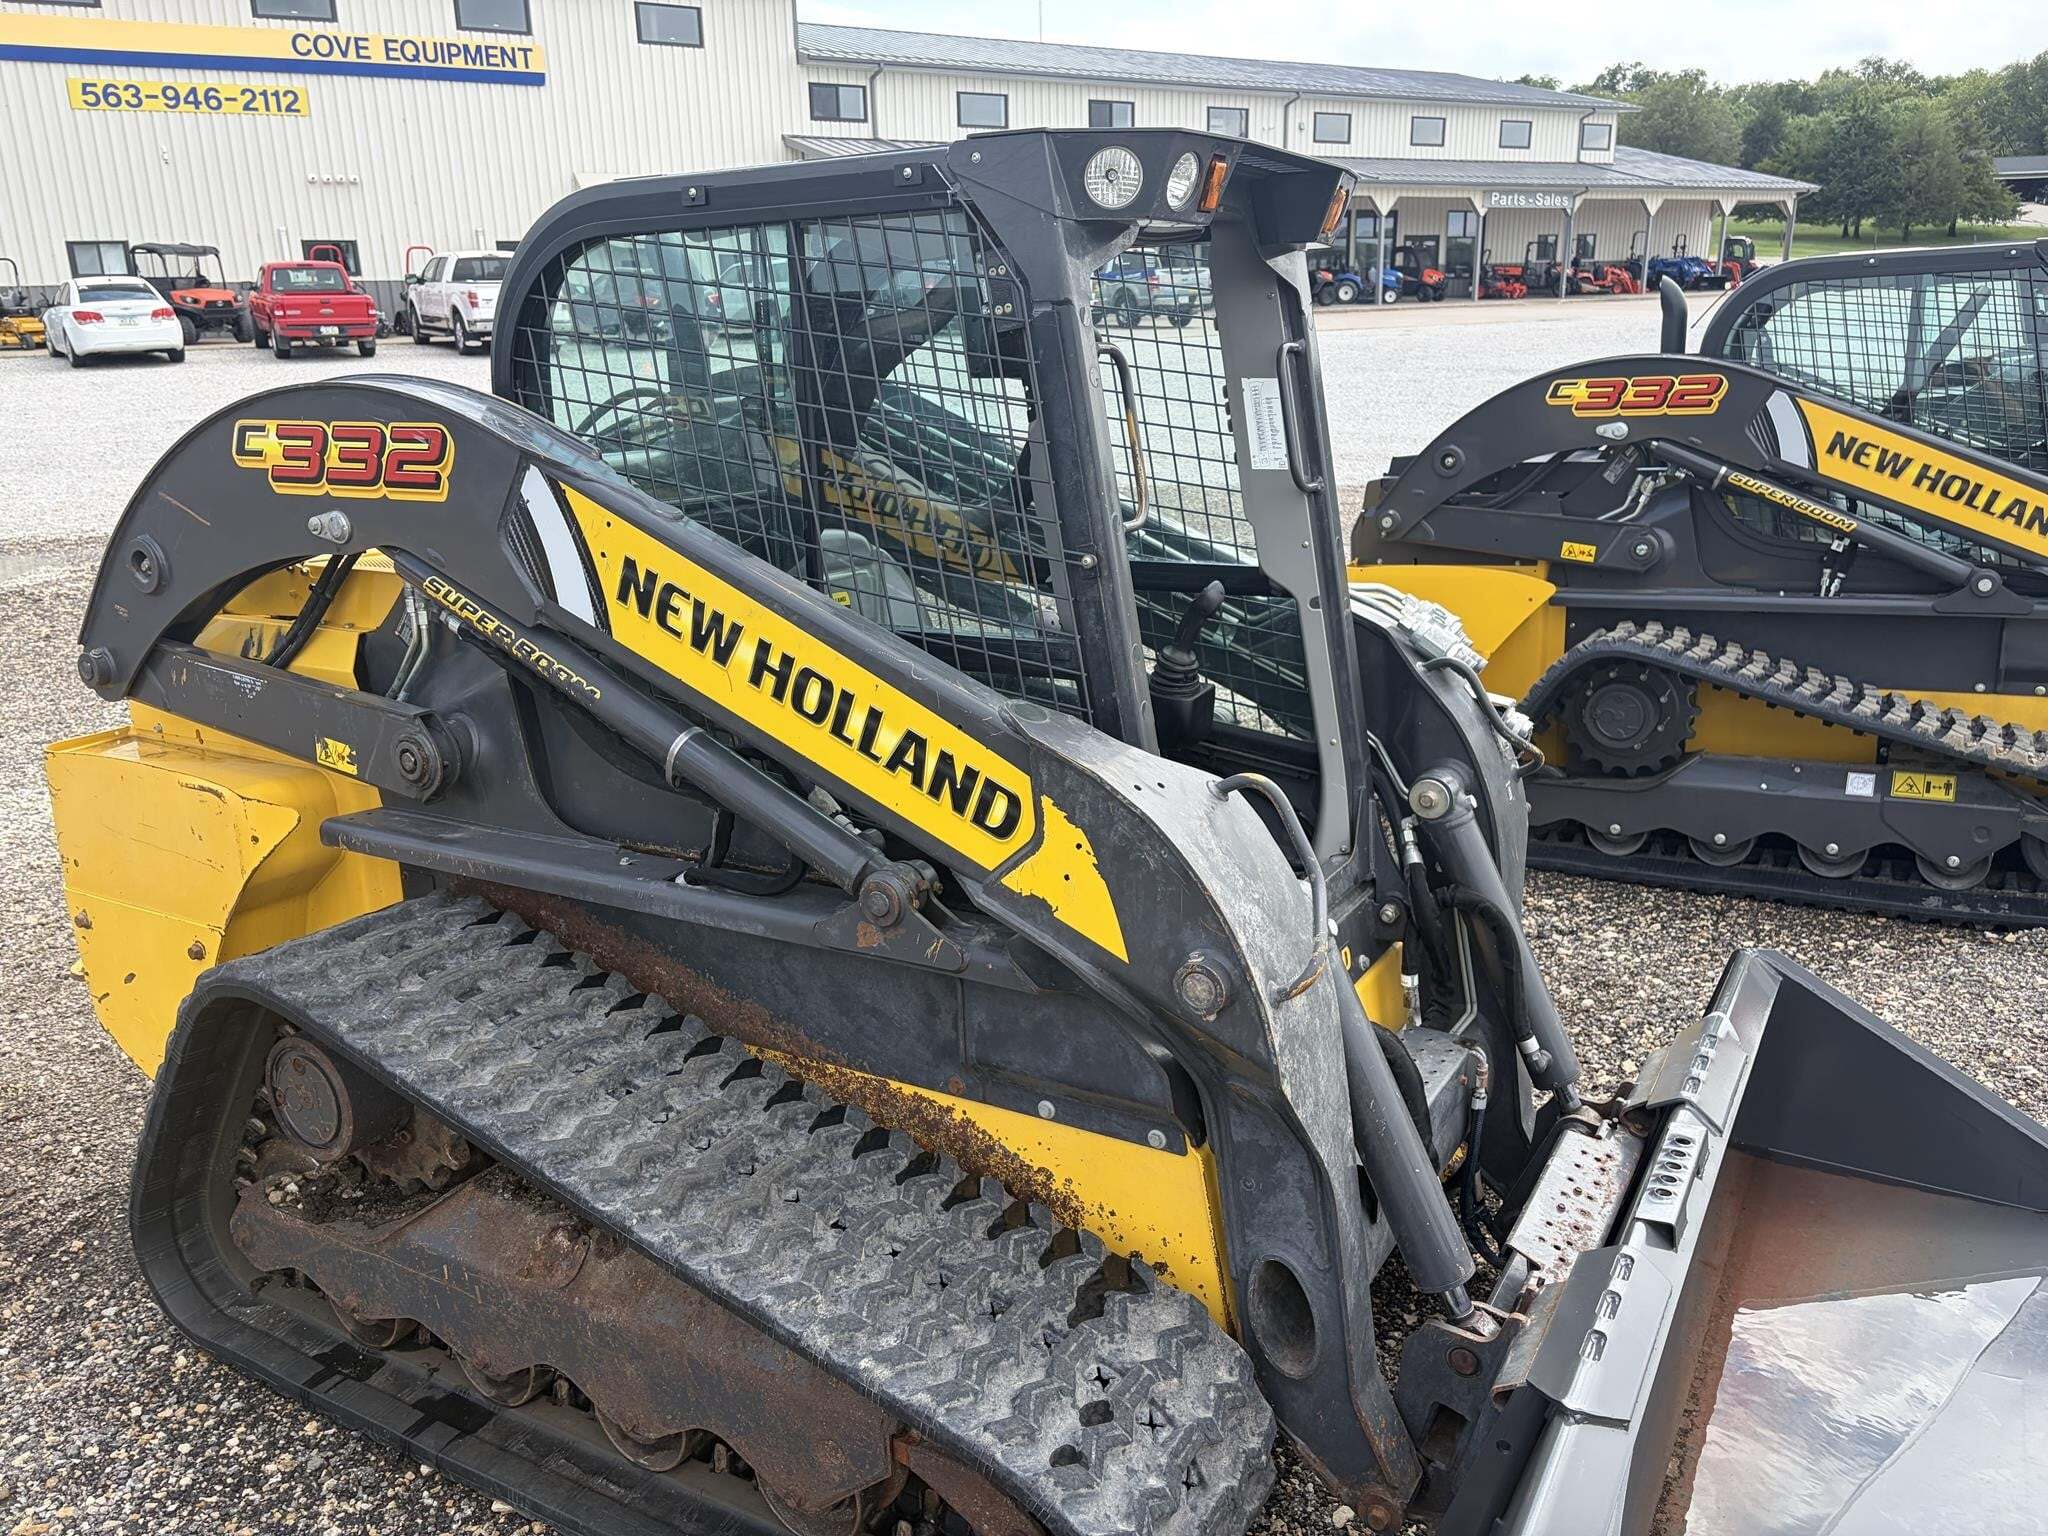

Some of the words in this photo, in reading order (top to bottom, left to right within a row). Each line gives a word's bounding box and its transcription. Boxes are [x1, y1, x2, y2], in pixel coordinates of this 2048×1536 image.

[291, 33, 371, 60] COVE
[383, 38, 533, 69] EQUIPMENT
[81, 82, 301, 113] 563-946-2112
[1491, 191, 1526, 206] Parts
[1535, 192, 1569, 207] Sales
[1547, 375, 1727, 416] C332
[233, 421, 452, 500] C332
[1826, 431, 1913, 479] NEW
[1728, 472, 1796, 508] SUPER
[1794, 498, 1857, 533] BOOM
[616, 556, 744, 668] NEW
[747, 638, 1022, 842] HOLLAND
